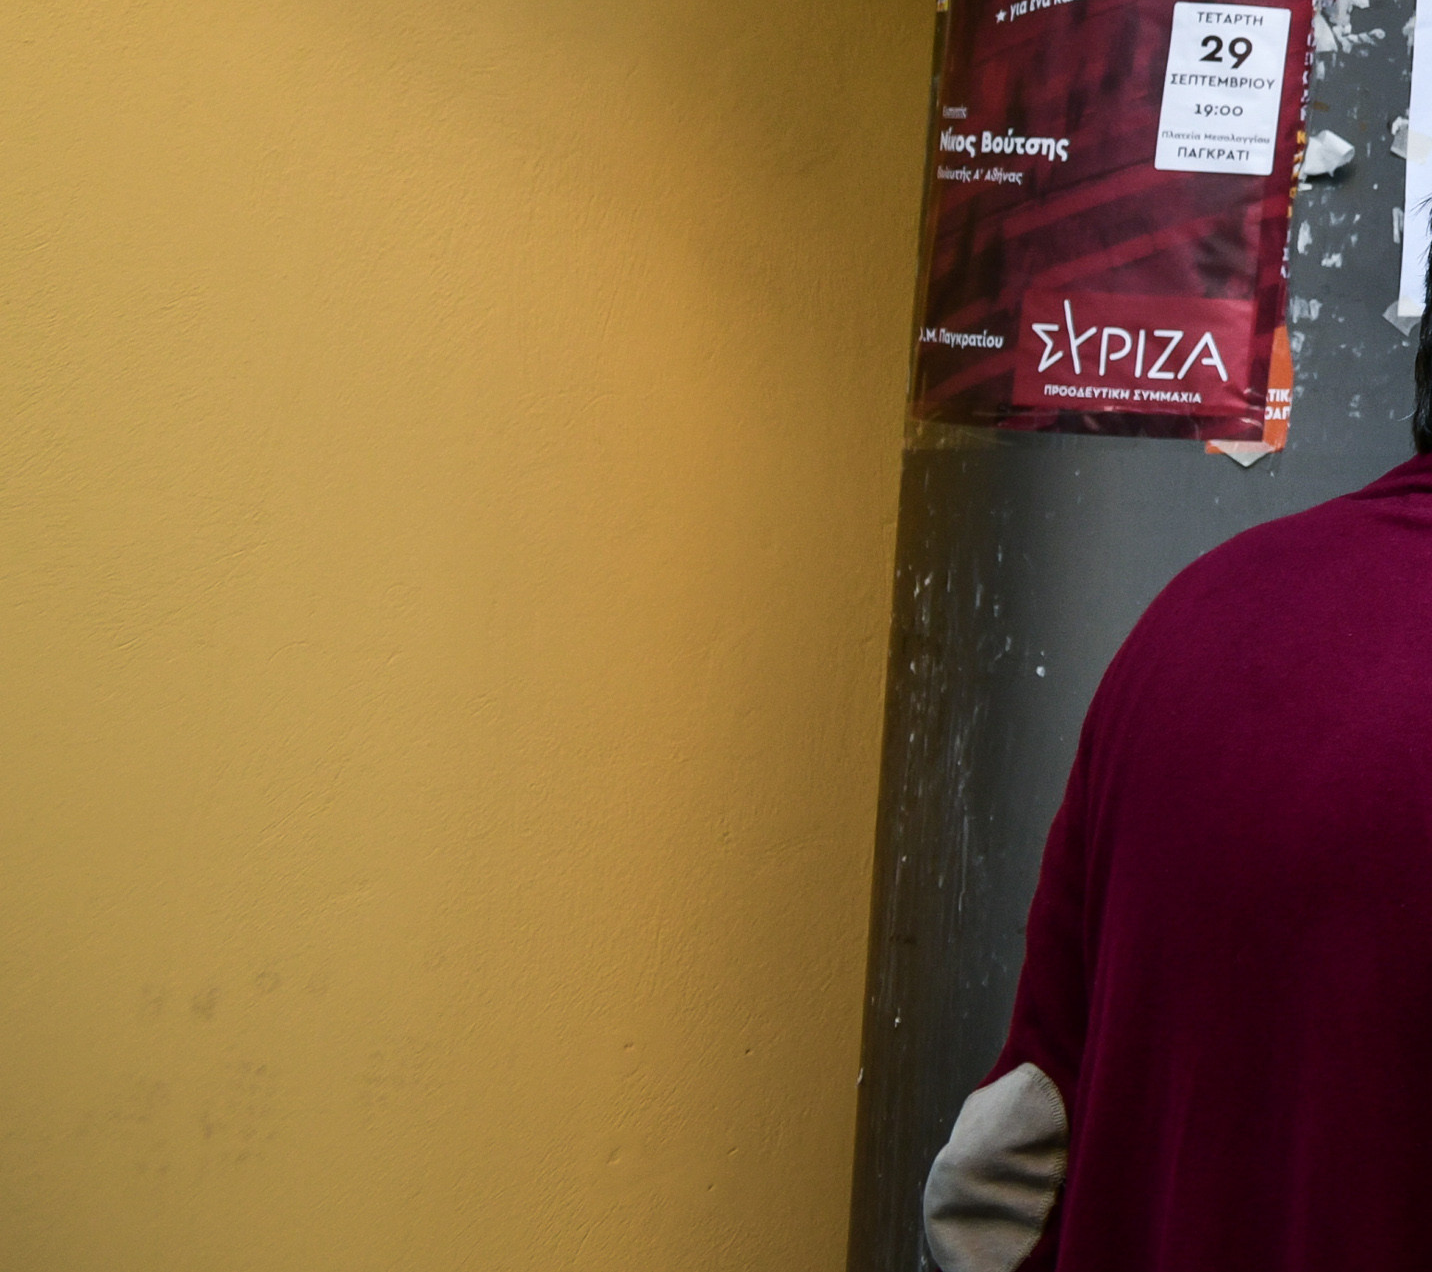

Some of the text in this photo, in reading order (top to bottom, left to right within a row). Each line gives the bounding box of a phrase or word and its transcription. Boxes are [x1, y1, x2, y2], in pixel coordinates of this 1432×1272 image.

[1009, 0, 1027, 22] για
[1197, 11, 1264, 27] ΤΕΤΑΡΤΗ
[1199, 35, 1253, 69] 29
[1170, 73, 1276, 90] ΣΕΠΤΕΜΒΡΙΟΥ
[1194, 103, 1243, 117] 19:00
[940, 126, 1071, 162] Νίκος Βούτσης
[1178, 146, 1250, 161] ΠΑΓΚΡΑΤΙ
[938, 326, 1005, 351] Παγκρατίου
[1032, 299, 1229, 383] ΣΥΡΙΖΑ
[1044, 384, 1202, 404] ΠΡΟΟΔΕΥΤΙΚΗ ΣΥΜΜΑΧΙΑ
